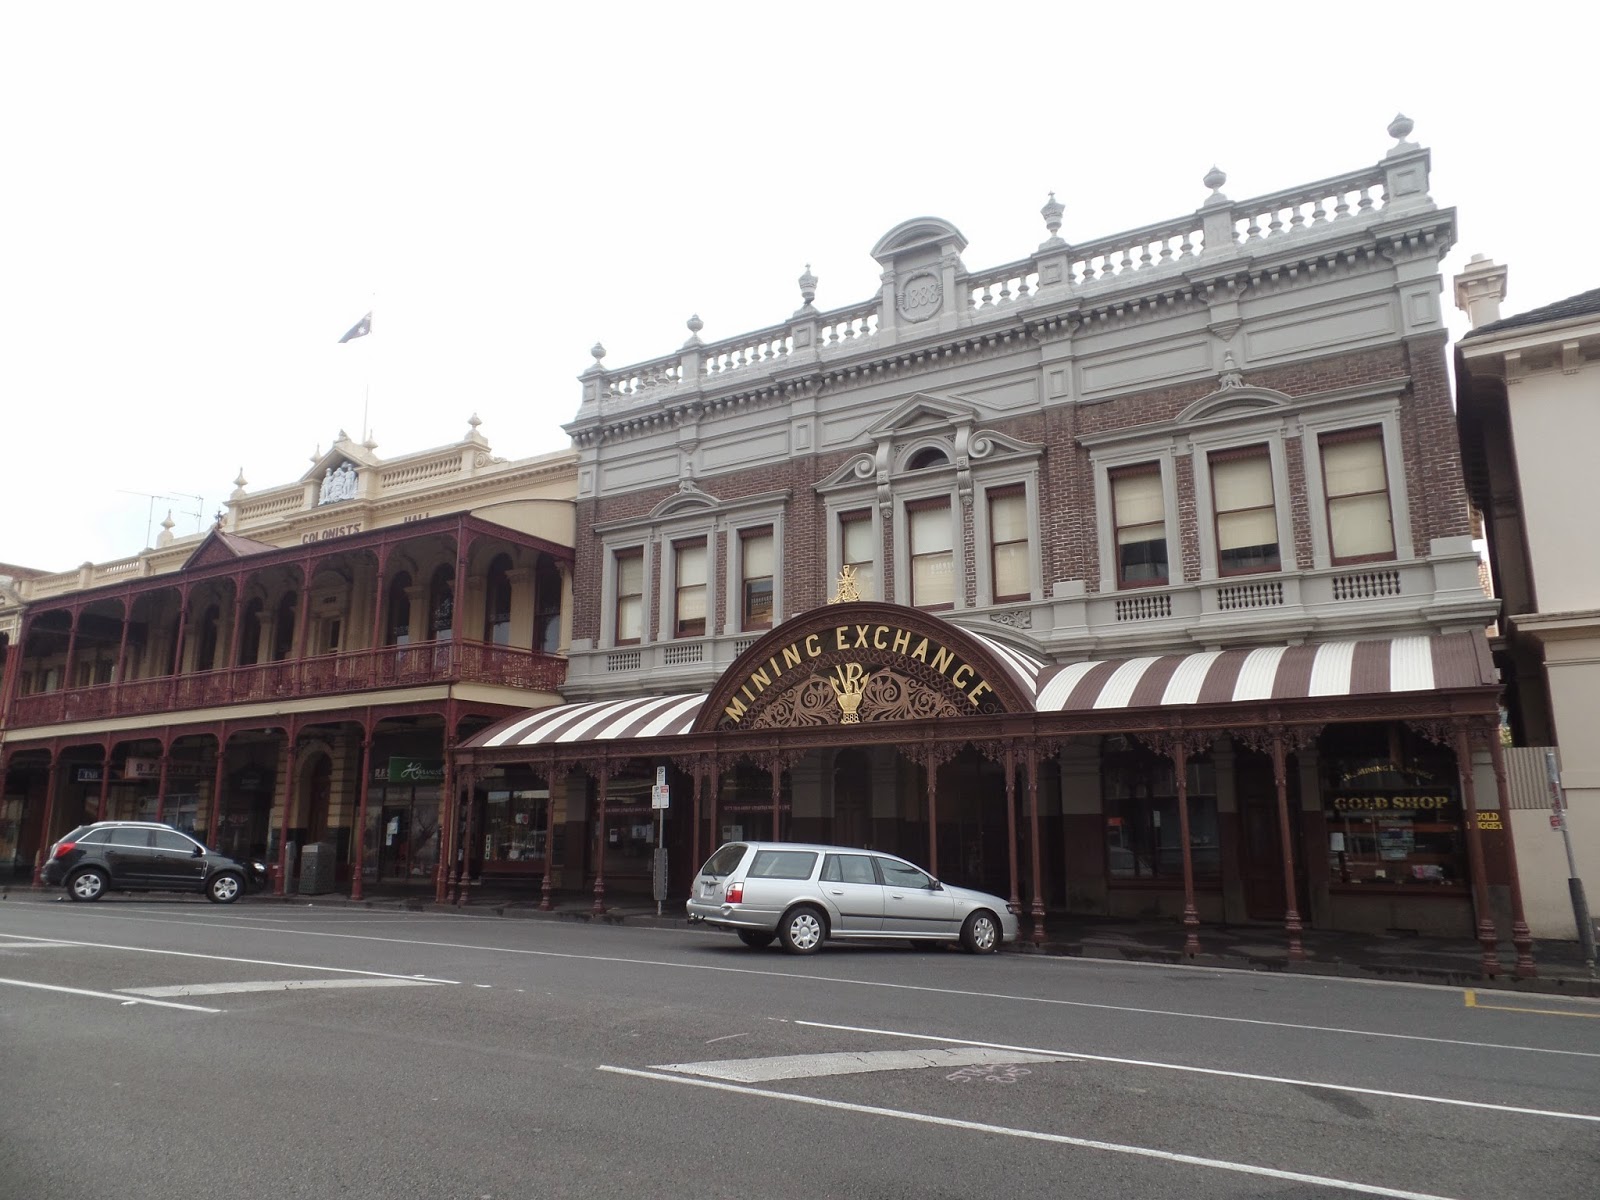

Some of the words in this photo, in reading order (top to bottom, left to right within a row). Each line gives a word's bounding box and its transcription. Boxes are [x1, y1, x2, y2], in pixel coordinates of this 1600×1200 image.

[904, 284, 939, 311] 1888
[724, 633, 822, 724] MINING
[835, 623, 994, 708] EXCHANGE
[1333, 796, 1389, 810] GOLD
[1392, 796, 1449, 810] SHOP
[1467, 821, 1503, 830] GGET
